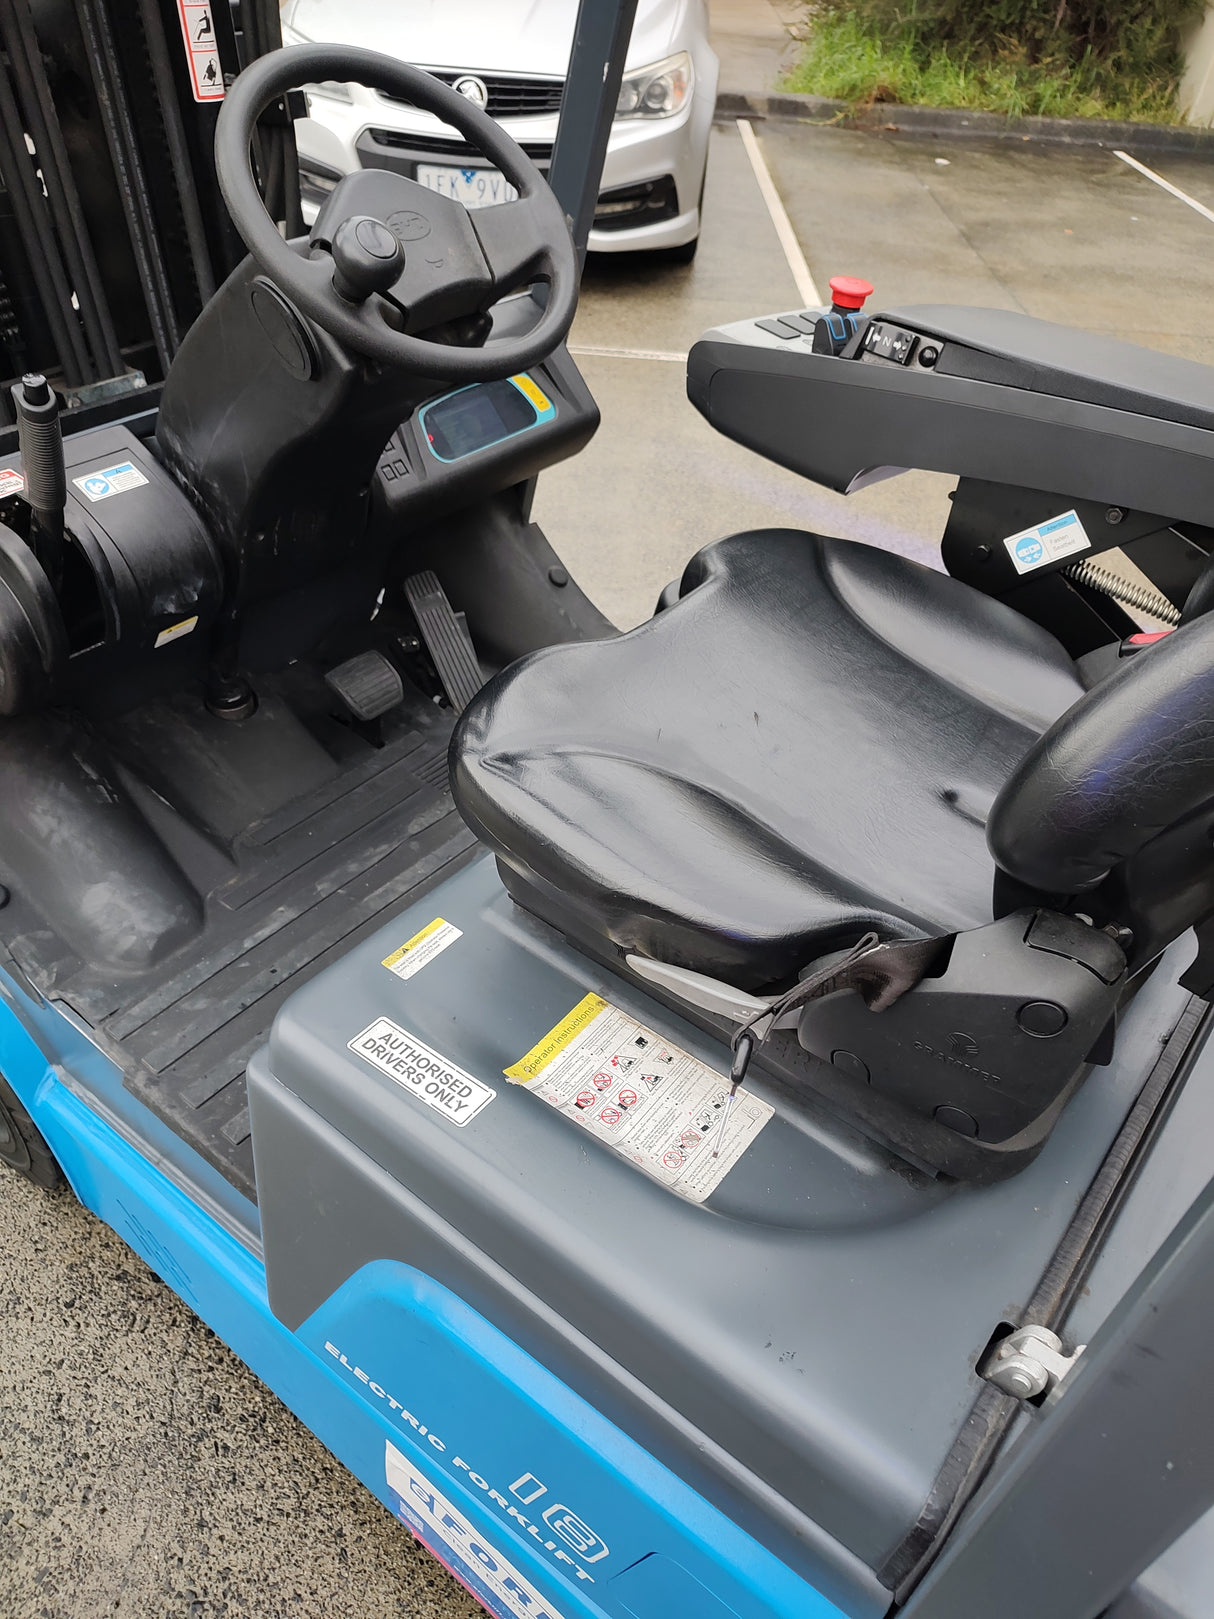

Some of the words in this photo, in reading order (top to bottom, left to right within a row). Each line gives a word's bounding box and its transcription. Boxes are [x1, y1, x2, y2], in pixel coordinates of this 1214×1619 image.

[882, 336, 892, 347] N
[361, 1038, 426, 1085] DRIVERS
[424, 1082, 469, 1113] ONLY
[378, 1032, 473, 1098] AUTHORISED
[523, 1043, 557, 1074] Operator
[554, 1006, 595, 1045] Instructions
[324, 1341, 447, 1452] ELECTRIC
[452, 1456, 595, 1584] FORKLIFT
[410, 1477, 552, 1619] eFOR
[508, 1472, 610, 1563] 18
